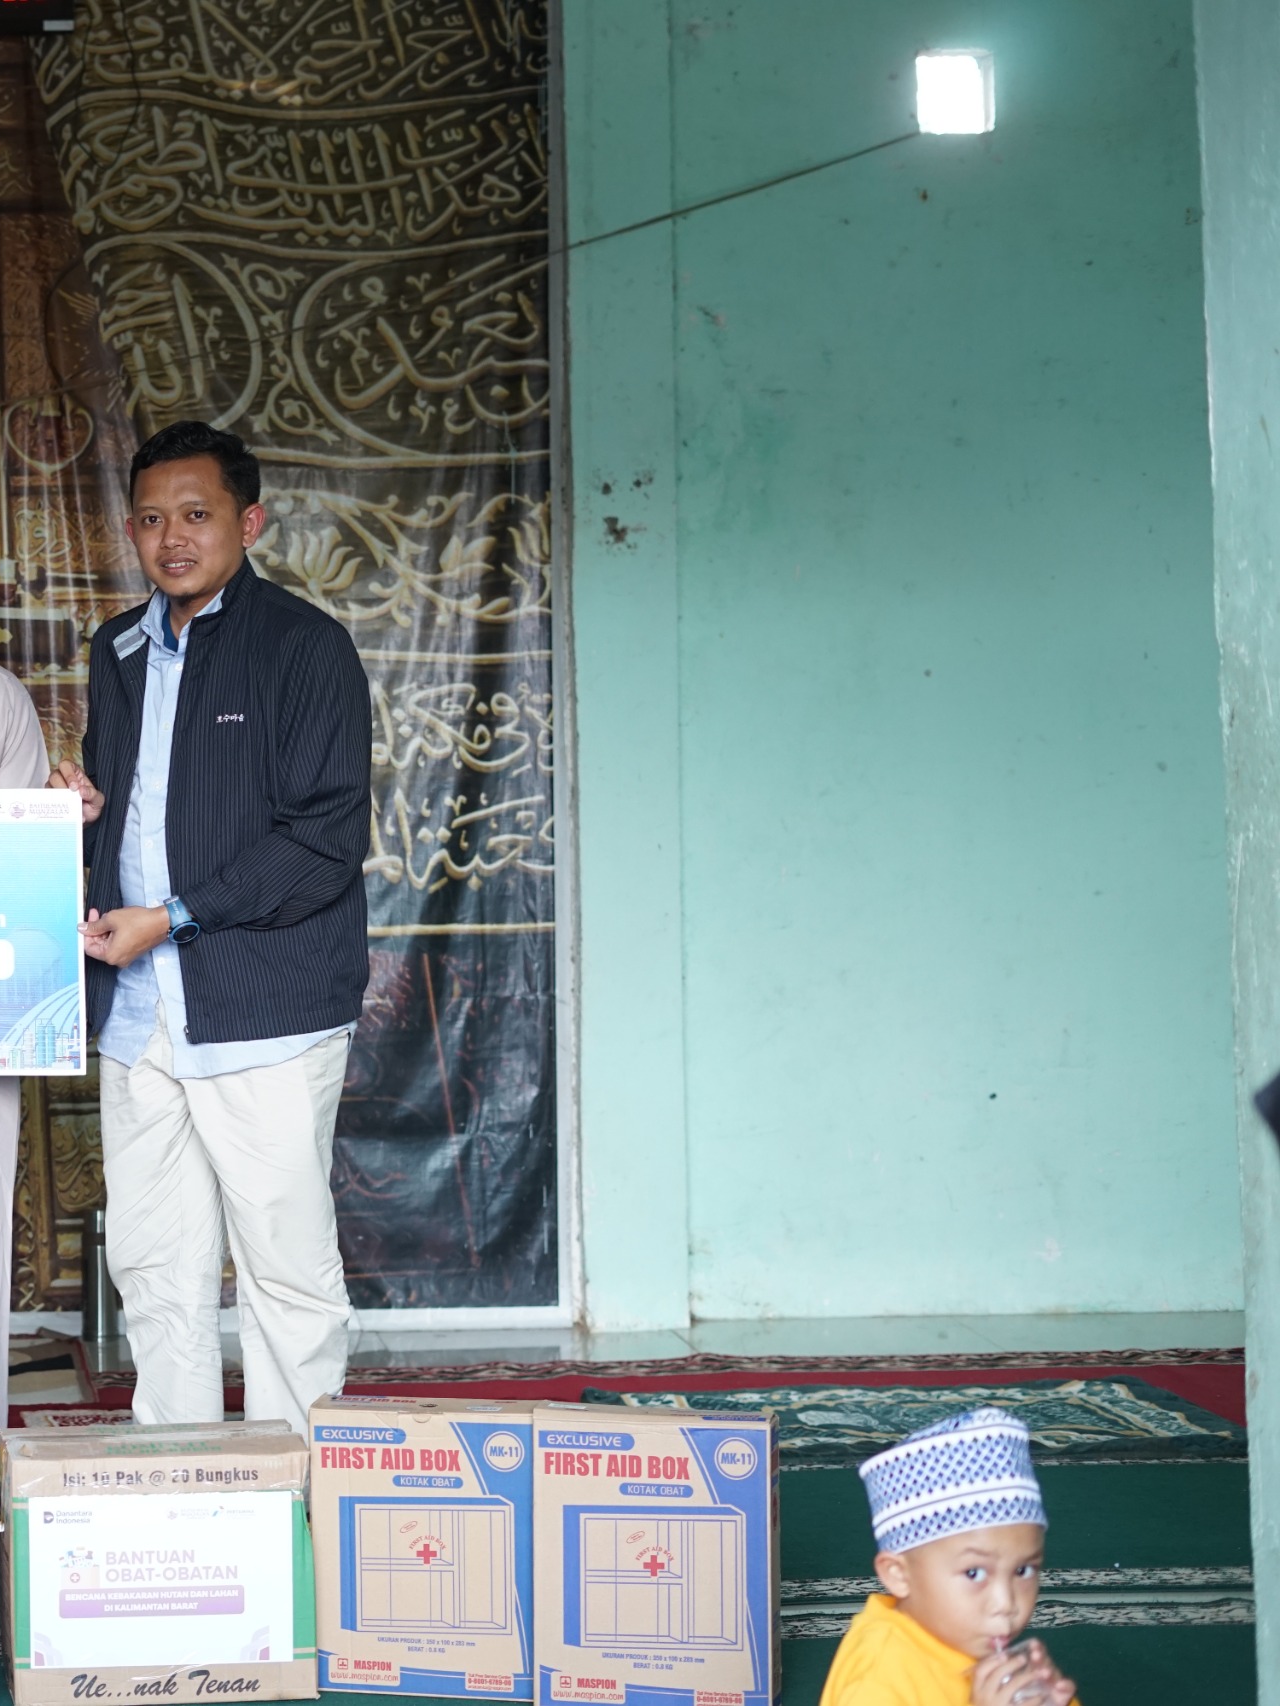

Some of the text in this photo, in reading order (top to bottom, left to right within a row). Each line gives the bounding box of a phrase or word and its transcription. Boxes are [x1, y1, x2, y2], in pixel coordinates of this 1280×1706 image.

[321, 1428, 395, 1441] EXCLUSIVE
[546, 1434, 622, 1447] EXCLUSIVE
[489, 1445, 519, 1458] MK-11
[320, 1446, 461, 1472] FIRST AID BOX
[720, 1452, 752, 1465] MK-11
[543, 1451, 690, 1480] FIRST AID BOX
[63, 1472, 86, 1487] Isi:
[116, 1471, 143, 1485] Pak
[149, 1470, 166, 1487] @
[196, 1467, 259, 1485] Bungkus
[400, 1476, 456, 1487] KOTAK OBAT
[627, 1485, 685, 1496] KOTAK OBAT
[409, 1536, 424, 1550] FIRST
[435, 1538, 447, 1550] BOX
[105, 1549, 195, 1565] BANTUAN
[635, 1547, 650, 1561] FIRST
[663, 1550, 675, 1562] BOX
[105, 1565, 238, 1582] OBAT-OBATAN
[65, 1589, 239, 1601] BENCANA KEBAKARAN HUTAN DAN LAHAN
[115, 1604, 170, 1612] KALIMANTAN
[171, 1602, 199, 1610] BARAT
[353, 1660, 392, 1671] MASPION
[187, 1669, 261, 1697] Tenan
[577, 1678, 617, 1690] MASPION
